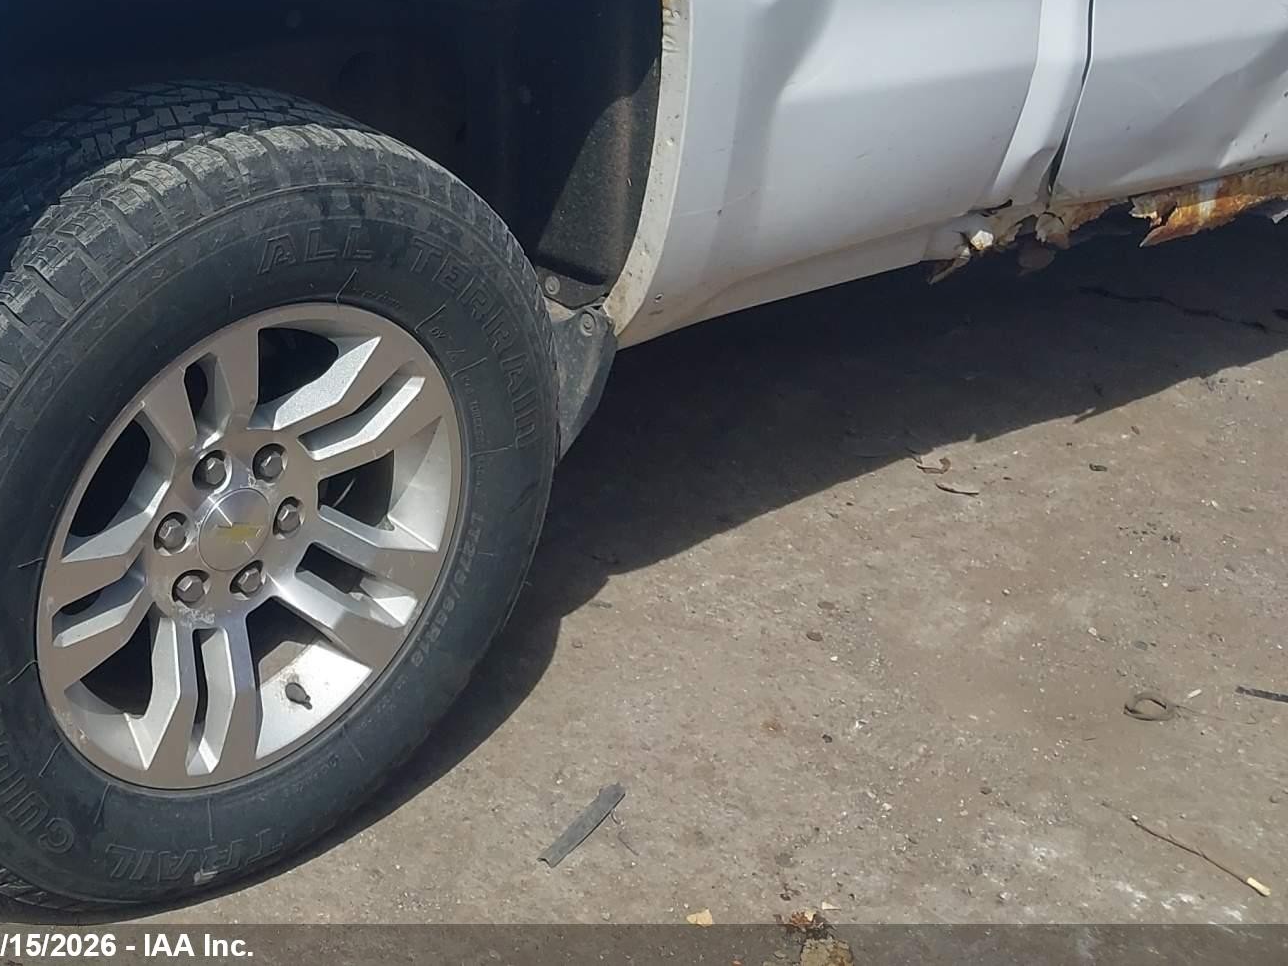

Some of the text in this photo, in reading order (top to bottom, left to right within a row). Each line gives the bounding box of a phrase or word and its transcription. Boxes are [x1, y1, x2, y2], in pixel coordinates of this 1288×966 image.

[256, 225, 540, 449] ALL TERRAIN
[105, 828, 284, 883] TRAIL
